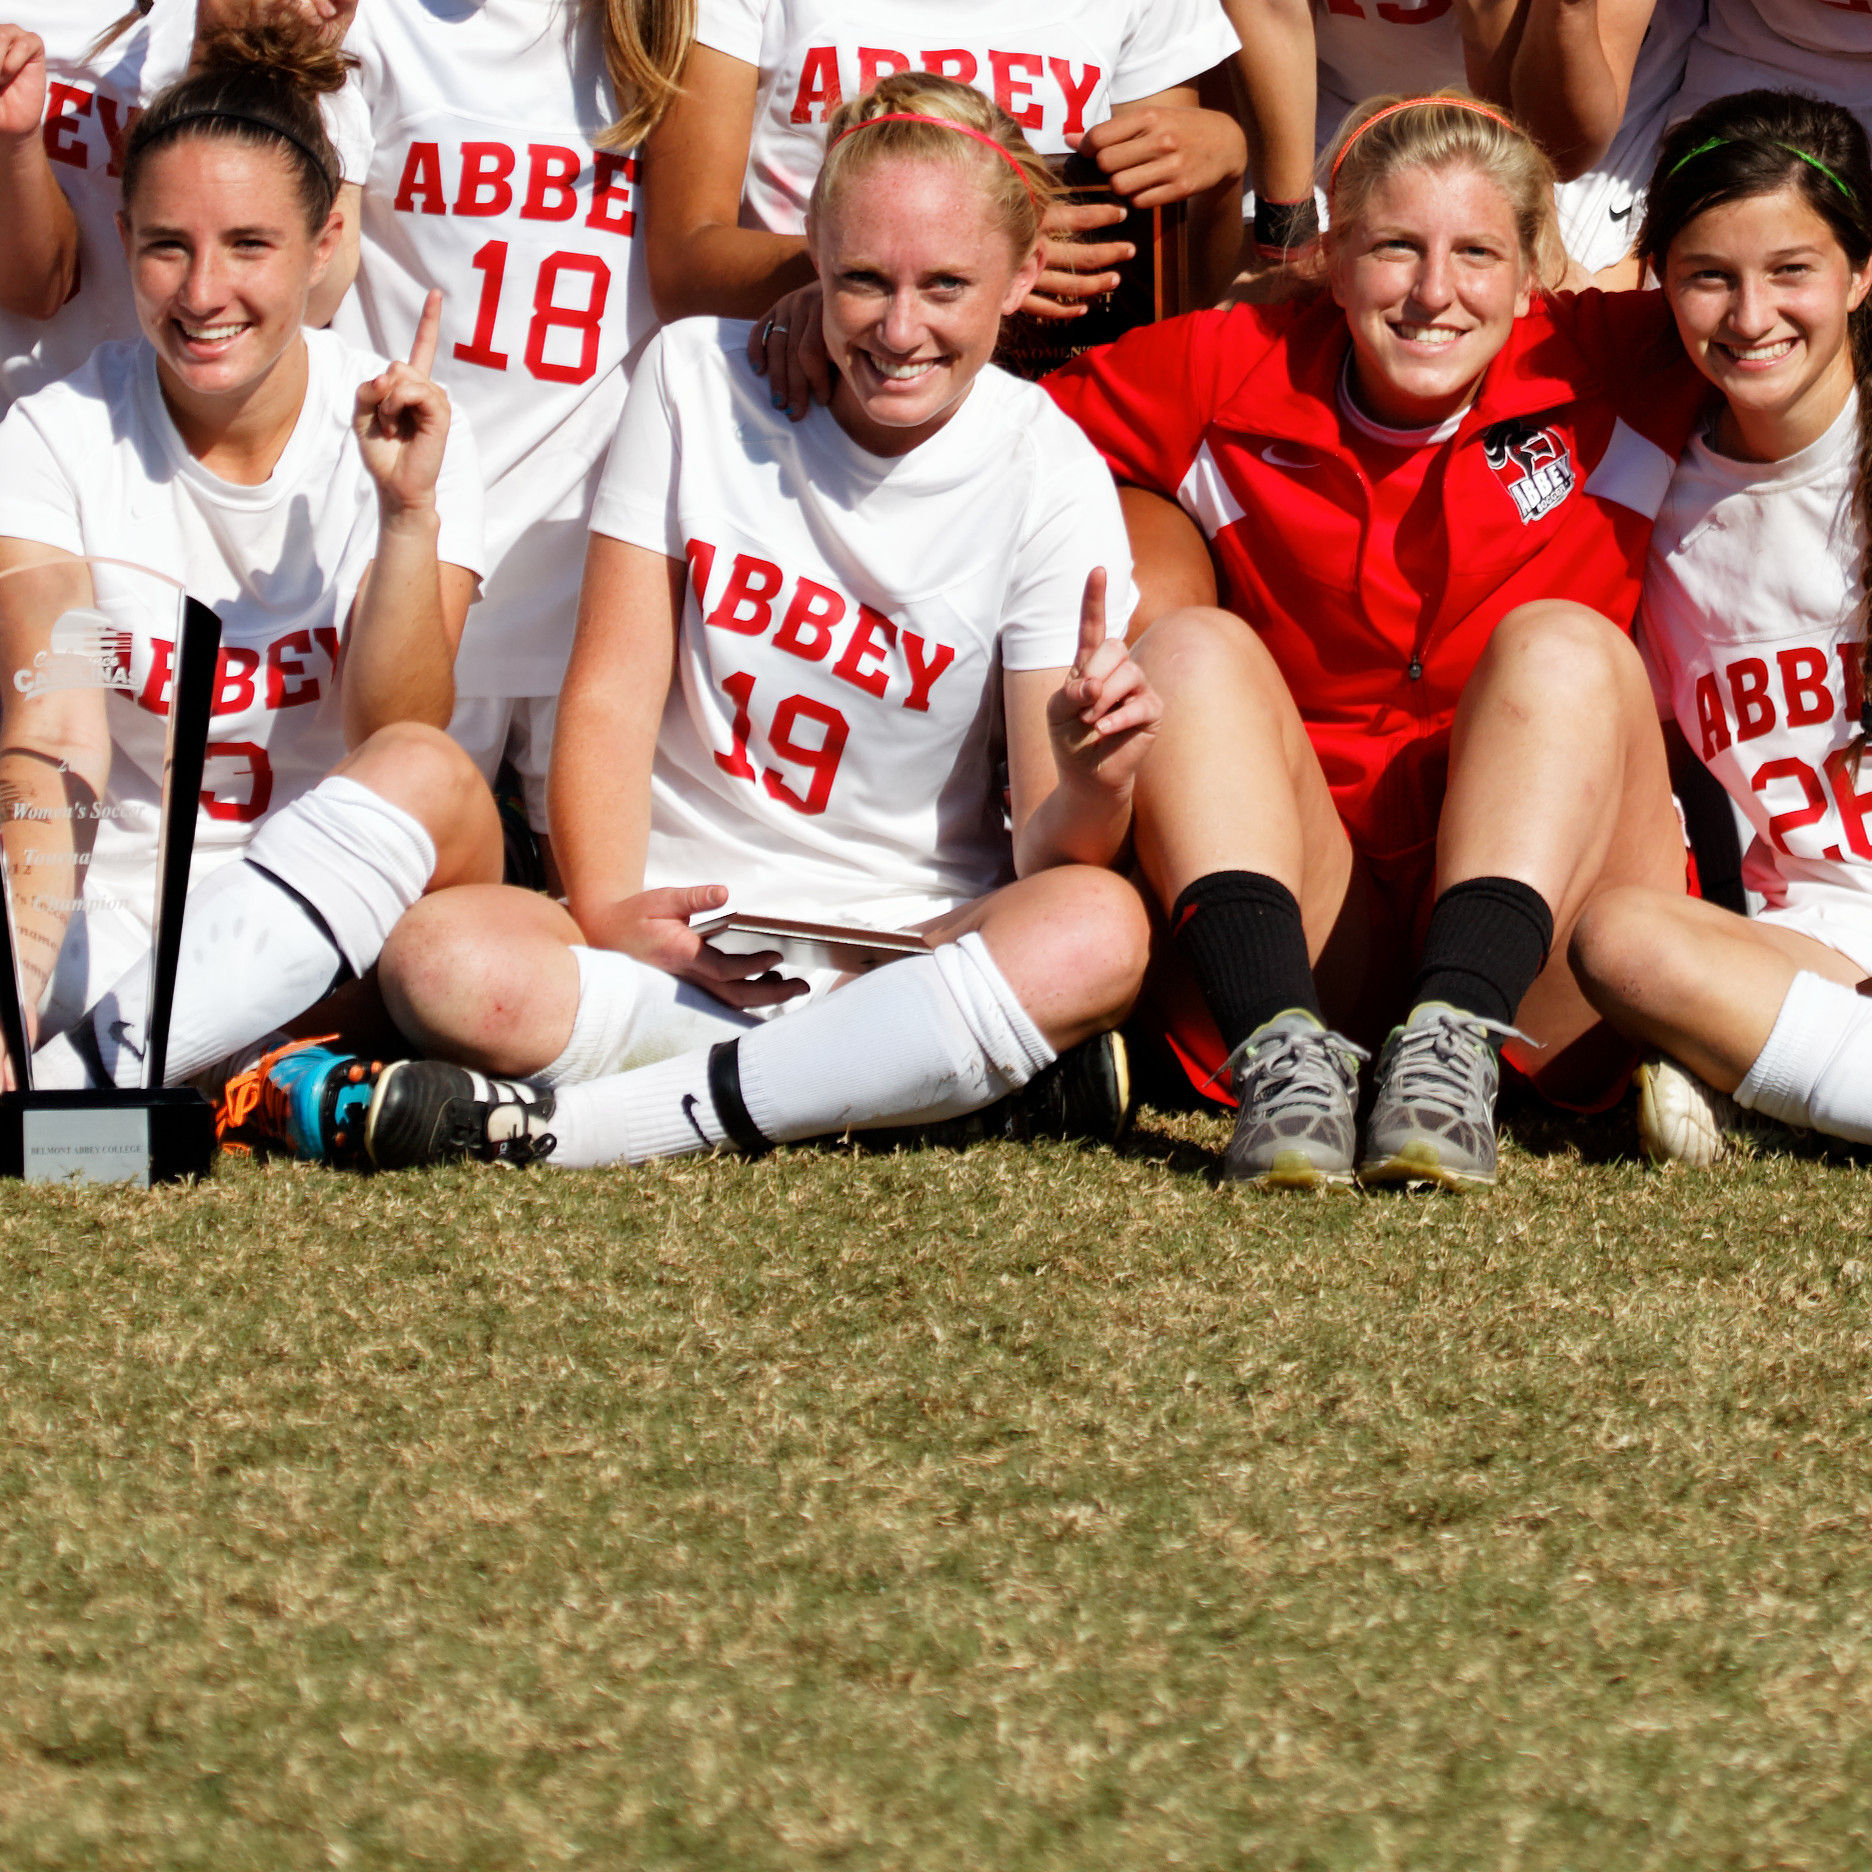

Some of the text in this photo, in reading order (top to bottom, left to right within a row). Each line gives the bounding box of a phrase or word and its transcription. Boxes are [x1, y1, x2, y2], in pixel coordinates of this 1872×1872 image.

[394, 141, 644, 239] ABBE
[453, 239, 612, 386] 18
[1509, 455, 1570, 520] ABBEY
[13, 668, 138, 694] CANAS
[98, 626, 340, 716] BBE
[713, 671, 851, 817] 19
[13, 801, 147, 821] Women's Soccer
[24, 848, 136, 868] Tourna
[30, 1144, 143, 1156] BELMONT ABBEY COLLEGE
